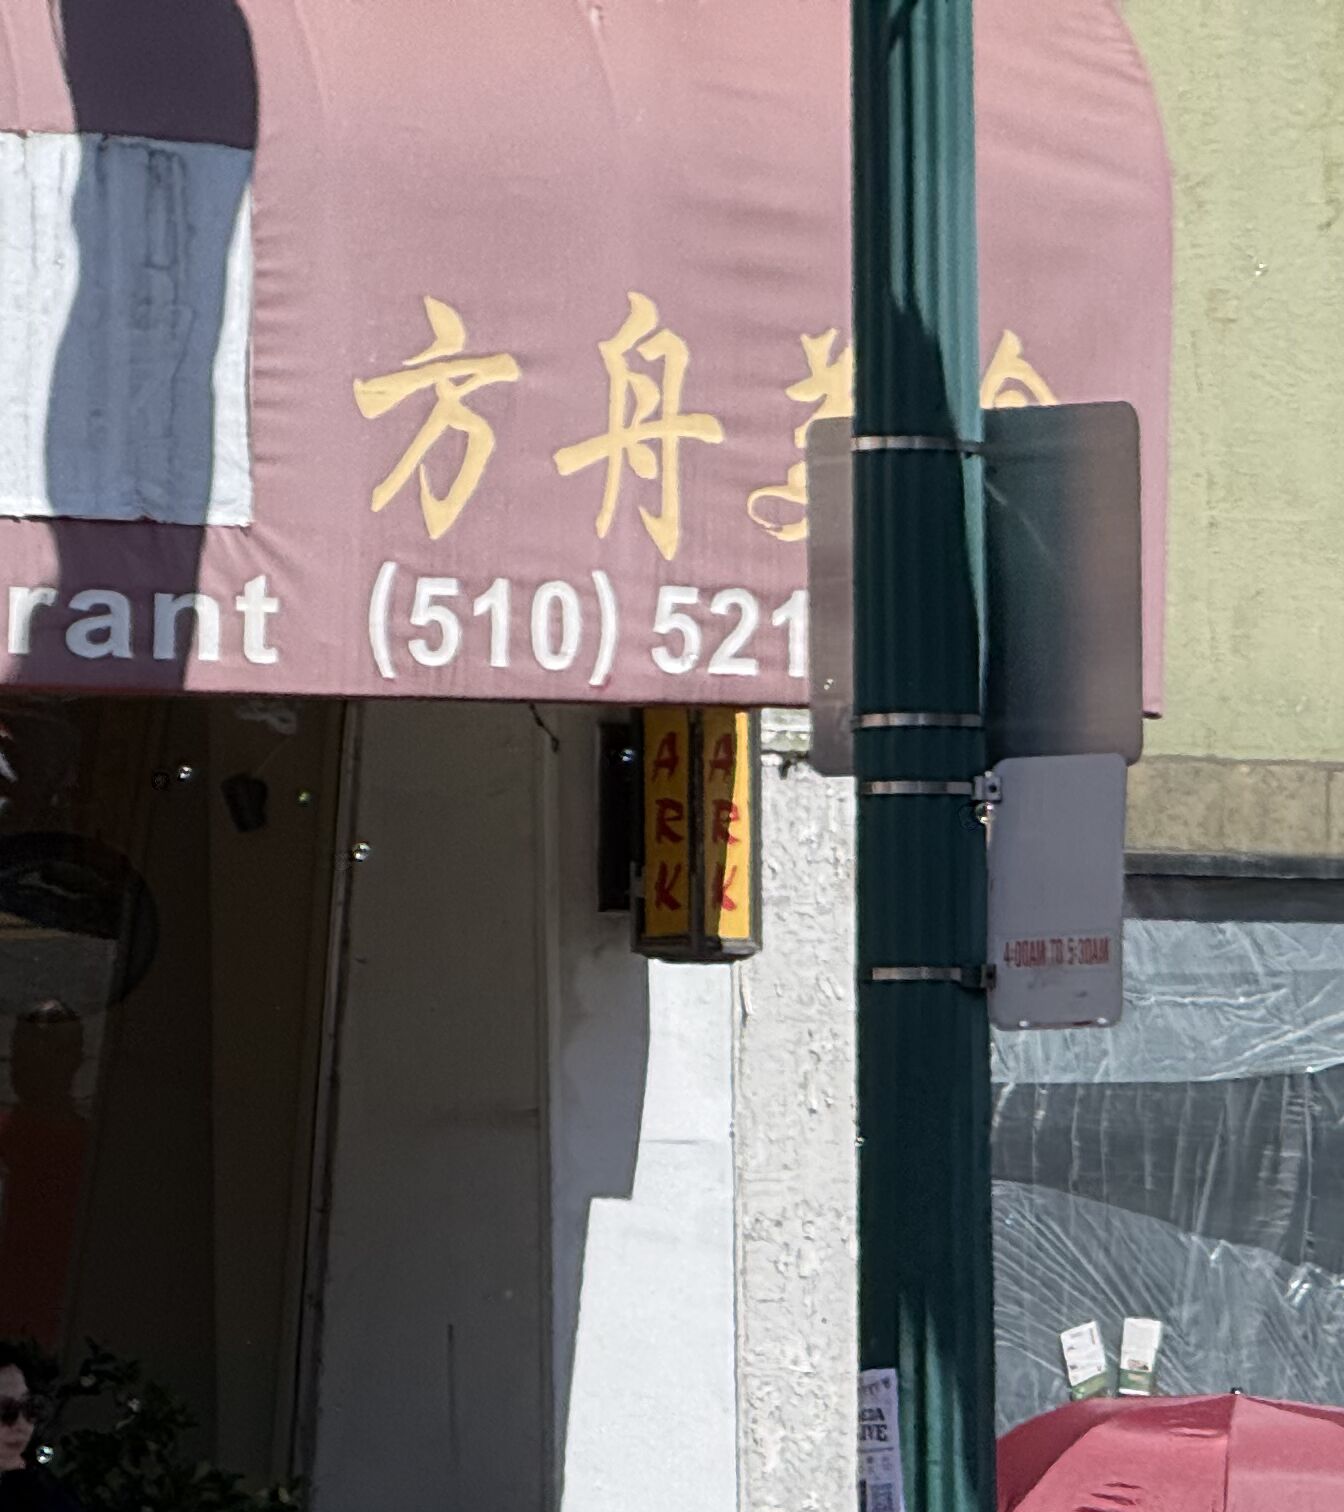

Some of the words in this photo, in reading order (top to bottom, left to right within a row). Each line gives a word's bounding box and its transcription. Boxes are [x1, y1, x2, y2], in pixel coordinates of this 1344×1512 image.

[5, 573, 281, 667] rant
[369, 561, 619, 688] (510)
[650, 586, 809, 679] 521
[652, 730, 685, 913] ARK
[708, 730, 740, 912] ARK
